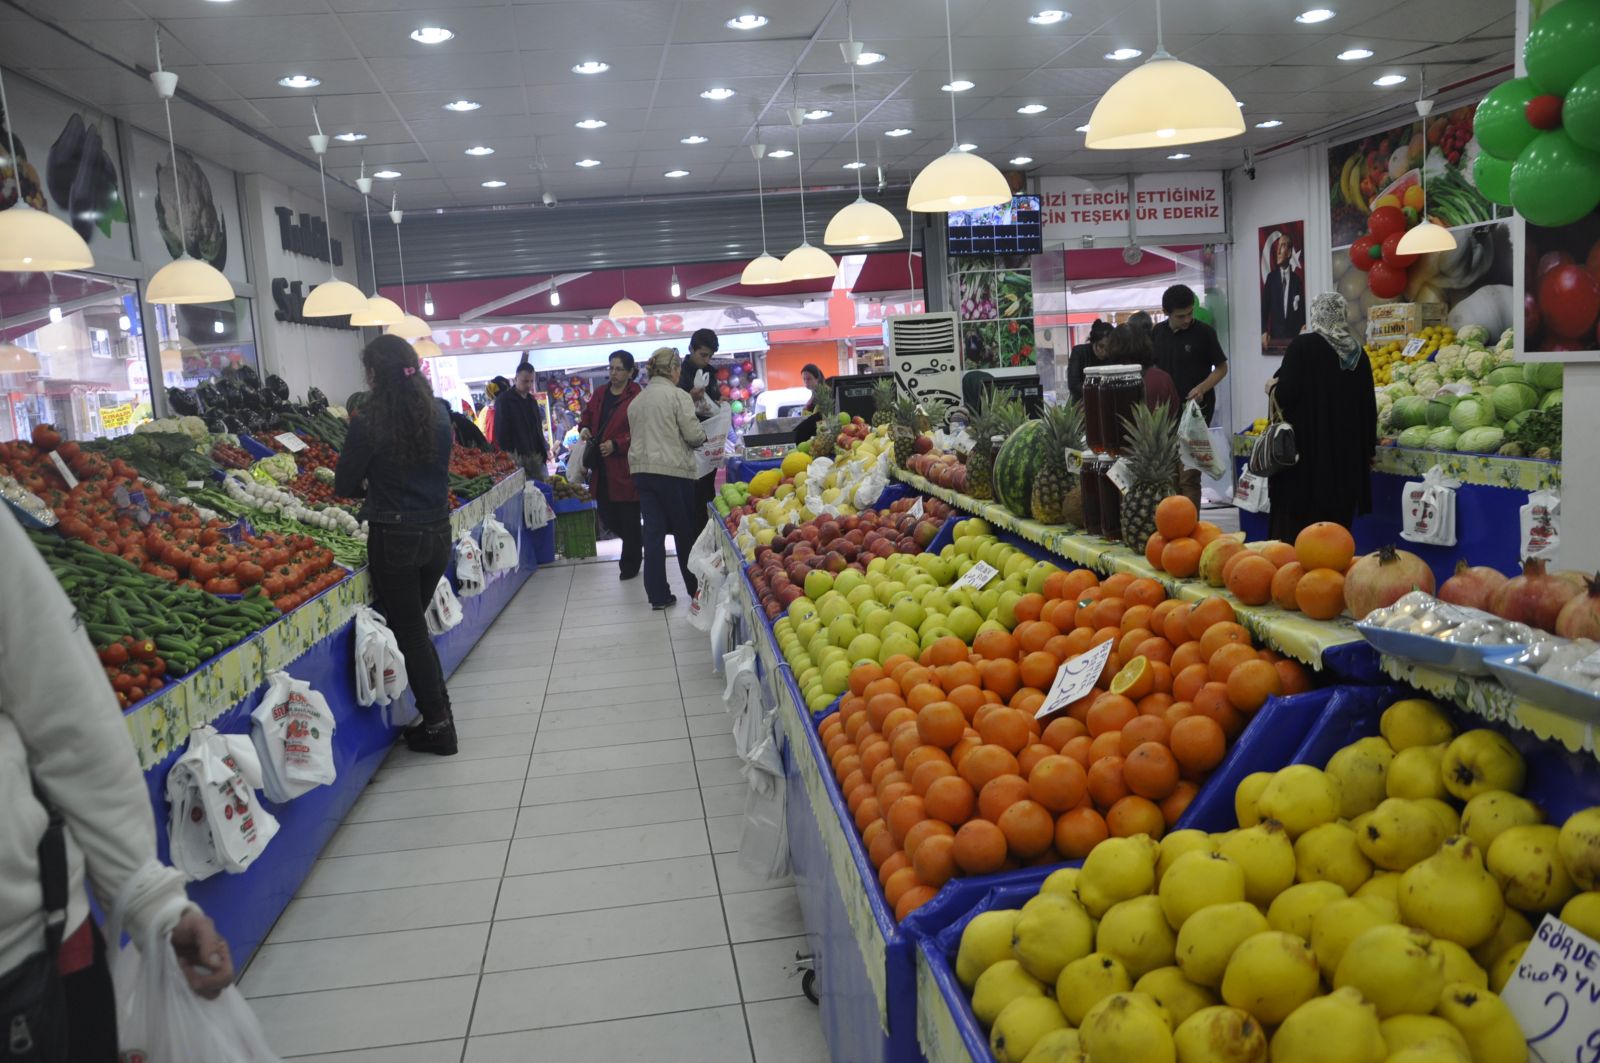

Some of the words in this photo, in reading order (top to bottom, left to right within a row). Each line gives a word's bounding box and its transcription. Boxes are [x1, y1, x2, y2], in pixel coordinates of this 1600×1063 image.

[1071, 189, 1130, 206] TERCİH
[1136, 186, 1216, 203] ETTİĞİNİZ
[1041, 209, 1066, 227] ÇİN
[1163, 203, 1220, 219] EDERİZ
